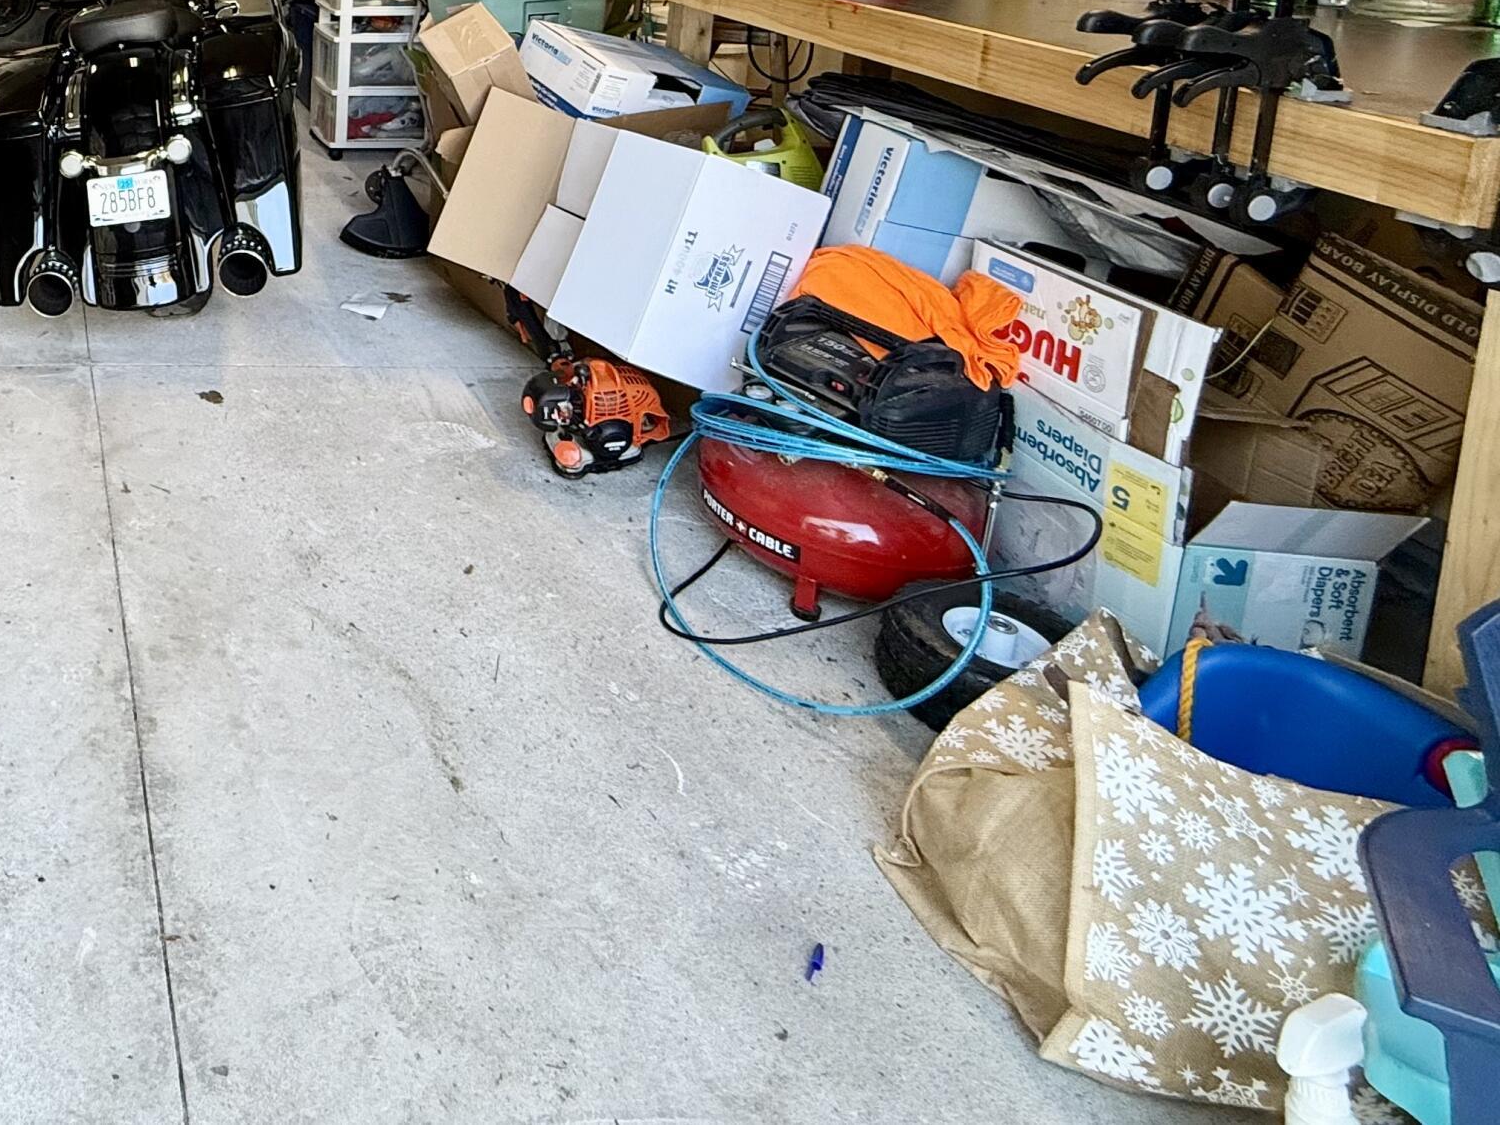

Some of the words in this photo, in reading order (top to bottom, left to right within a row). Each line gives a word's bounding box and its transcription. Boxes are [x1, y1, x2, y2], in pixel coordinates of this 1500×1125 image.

[532, 32, 559, 55] Victoria
[592, 106, 620, 115] Victoria
[866, 147, 894, 208] Victoria
[99, 186, 156, 215] 285BF8
[707, 255, 731, 296] EMPRESS
[1189, 246, 1216, 290] DISPLAY
[1315, 238, 1366, 274] BOAR
[1366, 270, 1439, 317] DISPLAY
[991, 319, 1082, 383] HUGG
[1036, 419, 1102, 473] Diapers
[1319, 428, 1377, 490] BRIGHT
[1112, 485, 1131, 512] 5
[703, 488, 734, 526] PORTER
[748, 527, 795, 559] CABLE
[1309, 566, 1333, 618] Diapers
[1335, 568, 1350, 578] &
[1328, 581, 1347, 611] Soft
[1339, 569, 1366, 642] Absorbent
